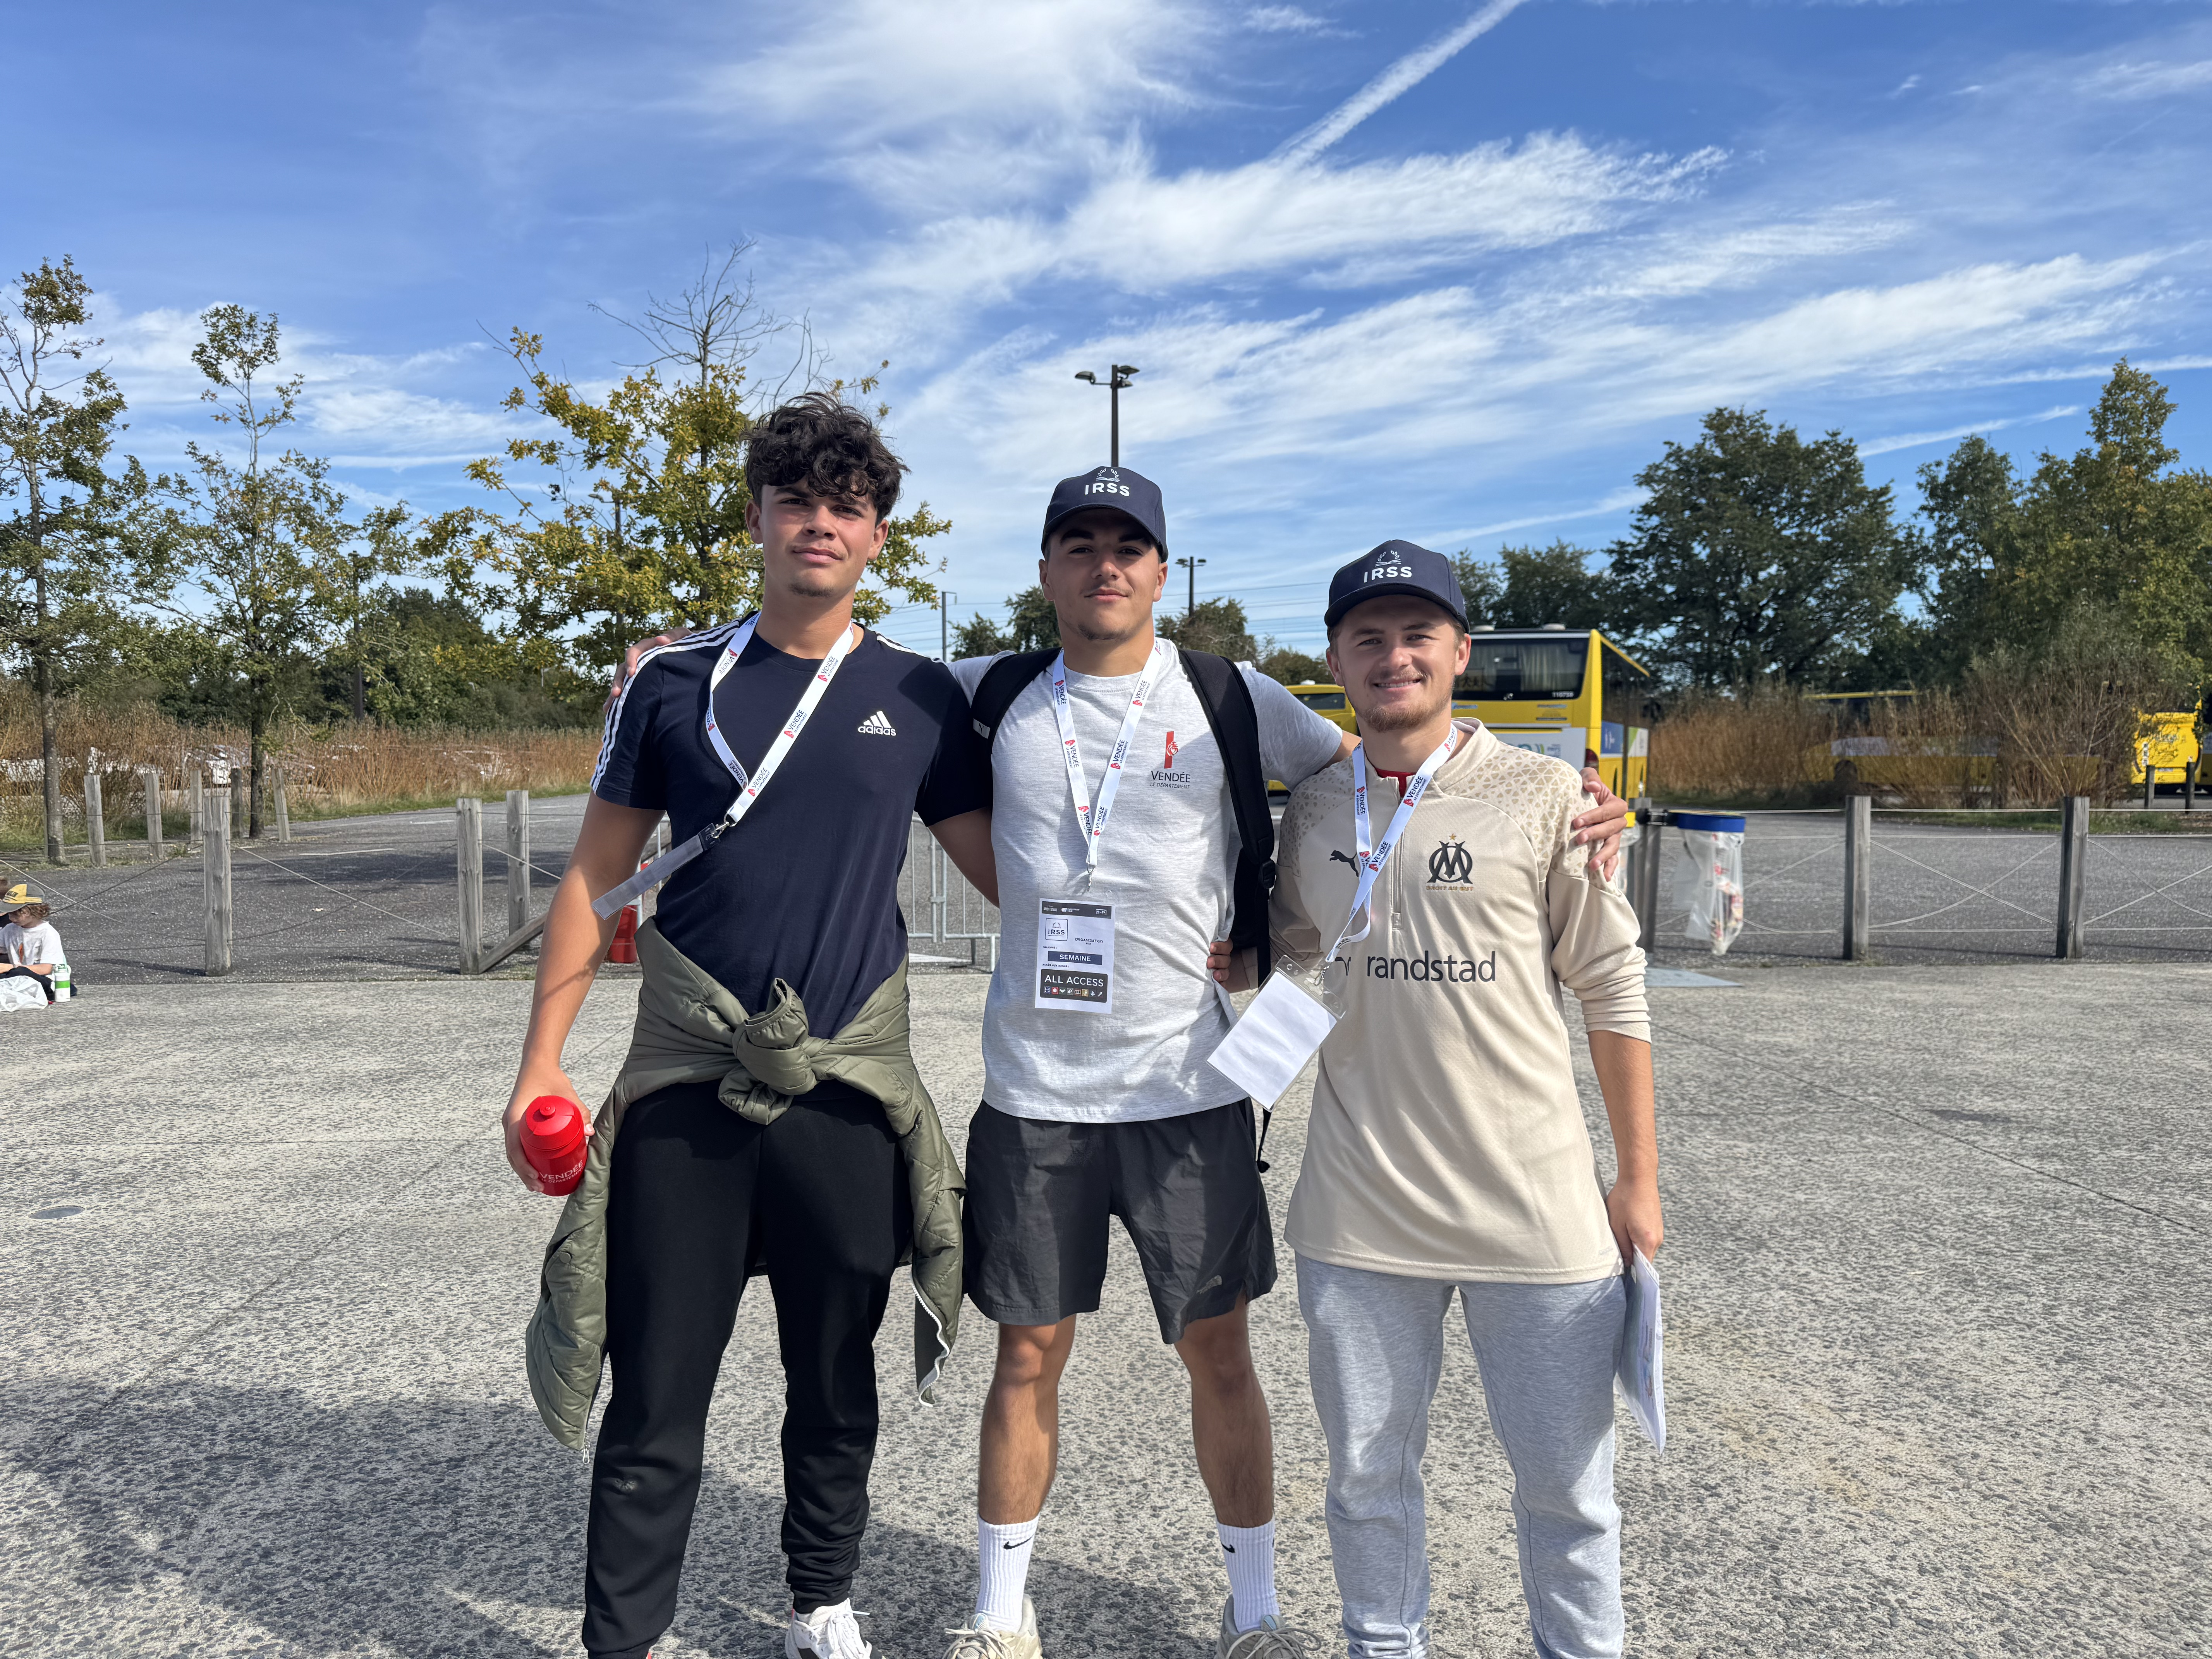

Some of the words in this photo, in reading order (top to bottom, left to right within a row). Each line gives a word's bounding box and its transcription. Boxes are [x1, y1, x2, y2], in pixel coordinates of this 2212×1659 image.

[1085, 483, 1130, 496] IRSS
[1364, 566, 1412, 583] IRSS
[821, 655, 835, 673] VENDÉE
[1059, 684, 1067, 705] VENDÉE
[1134, 680, 1147, 698] VENDÉE
[787, 709, 804, 730] VENDÉE
[858, 725, 896, 736] adidas
[1070, 745, 1080, 768] VENDÉE
[1113, 739, 1125, 761] VENDÉE
[751, 768, 768, 788] VENDÉE
[1151, 770, 1191, 783] VENDÉE
[1407, 776, 1424, 798] VENDÉE
[1095, 806, 1104, 829] VENDÉE
[1371, 841, 1389, 862] VENDÉE
[1367, 950, 1496, 982] randstad
[1044, 975, 1063, 984] ALL
[1066, 976, 1104, 987] ACCESS
[539, 1159, 583, 1180] VENDÉE
